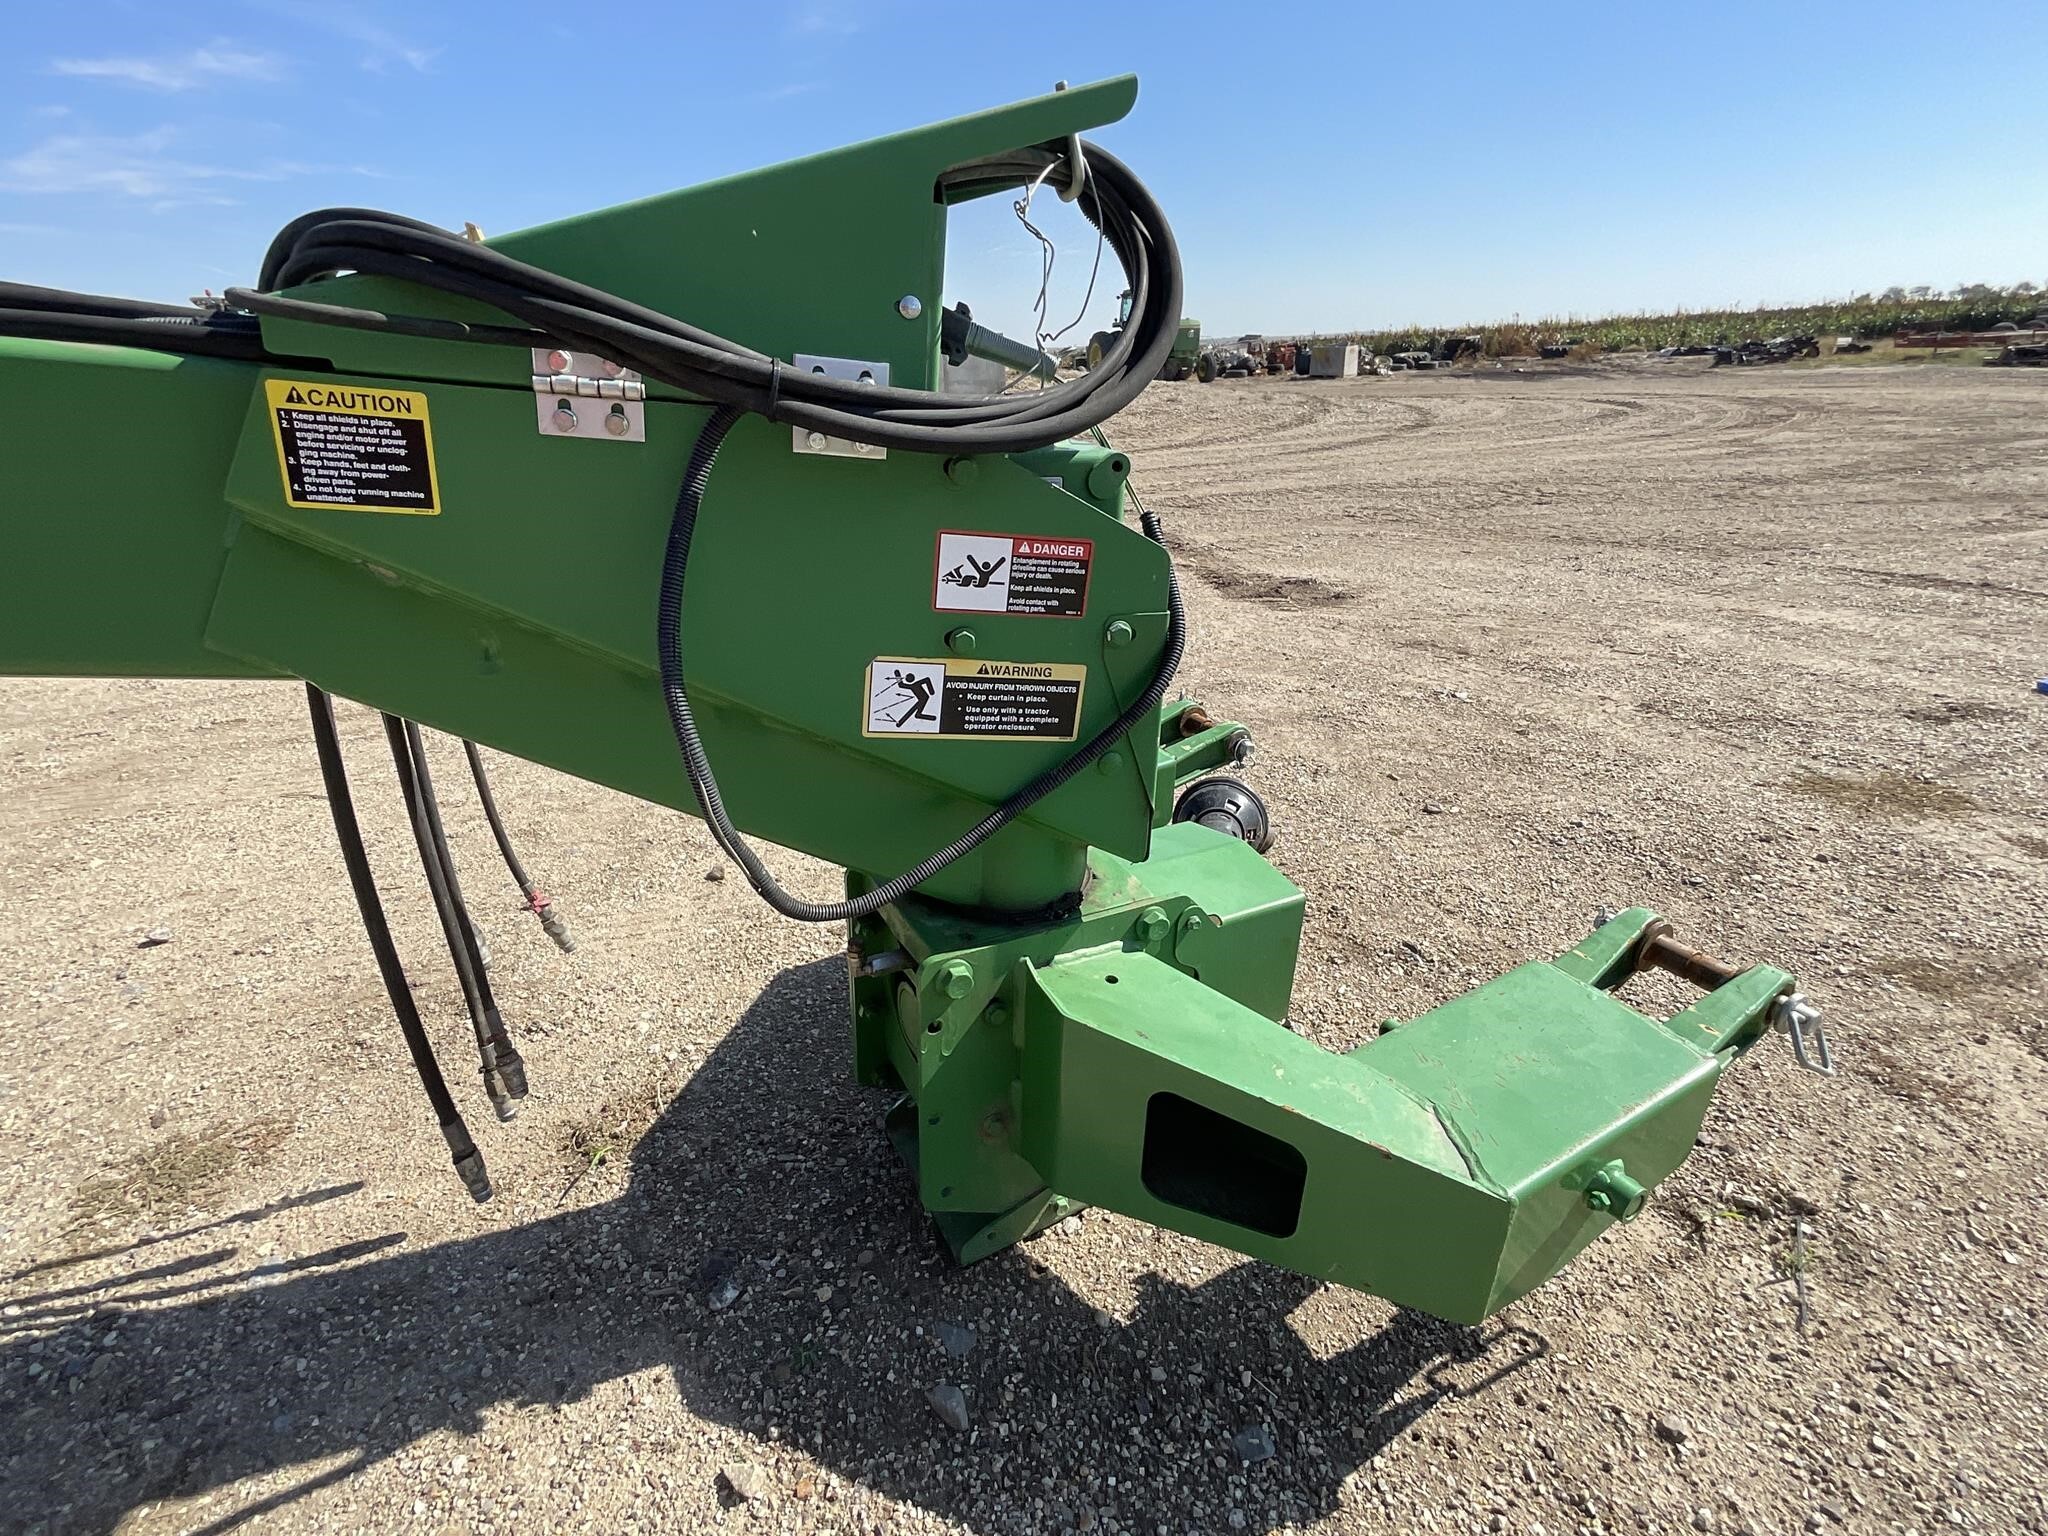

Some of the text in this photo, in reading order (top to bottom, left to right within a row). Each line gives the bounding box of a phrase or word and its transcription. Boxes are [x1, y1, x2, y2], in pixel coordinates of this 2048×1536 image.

[307, 390, 412, 413] CAUTION
[292, 412, 314, 422] Keep
[328, 416, 358, 424] shields
[371, 418, 395, 427] place.
[294, 422, 338, 432] Disengage
[296, 432, 324, 440] engine
[327, 433, 353, 442] and/or
[382, 437, 407, 446] power
[297, 440, 324, 448] before
[327, 442, 364, 452] servicing
[378, 446, 408, 456] unclog-
[299, 450, 358, 460] ging machine.
[300, 458, 322, 466] Keep
[324, 460, 352, 469] hands,
[302, 467, 315, 475] ing
[318, 469, 338, 477] away
[307, 494, 356, 503] unattended.
[358, 489, 389, 497] running
[1033, 543, 1084, 556] DANGER
[1013, 557, 1050, 566] Entanglement
[991, 665, 1052, 678] WARNING
